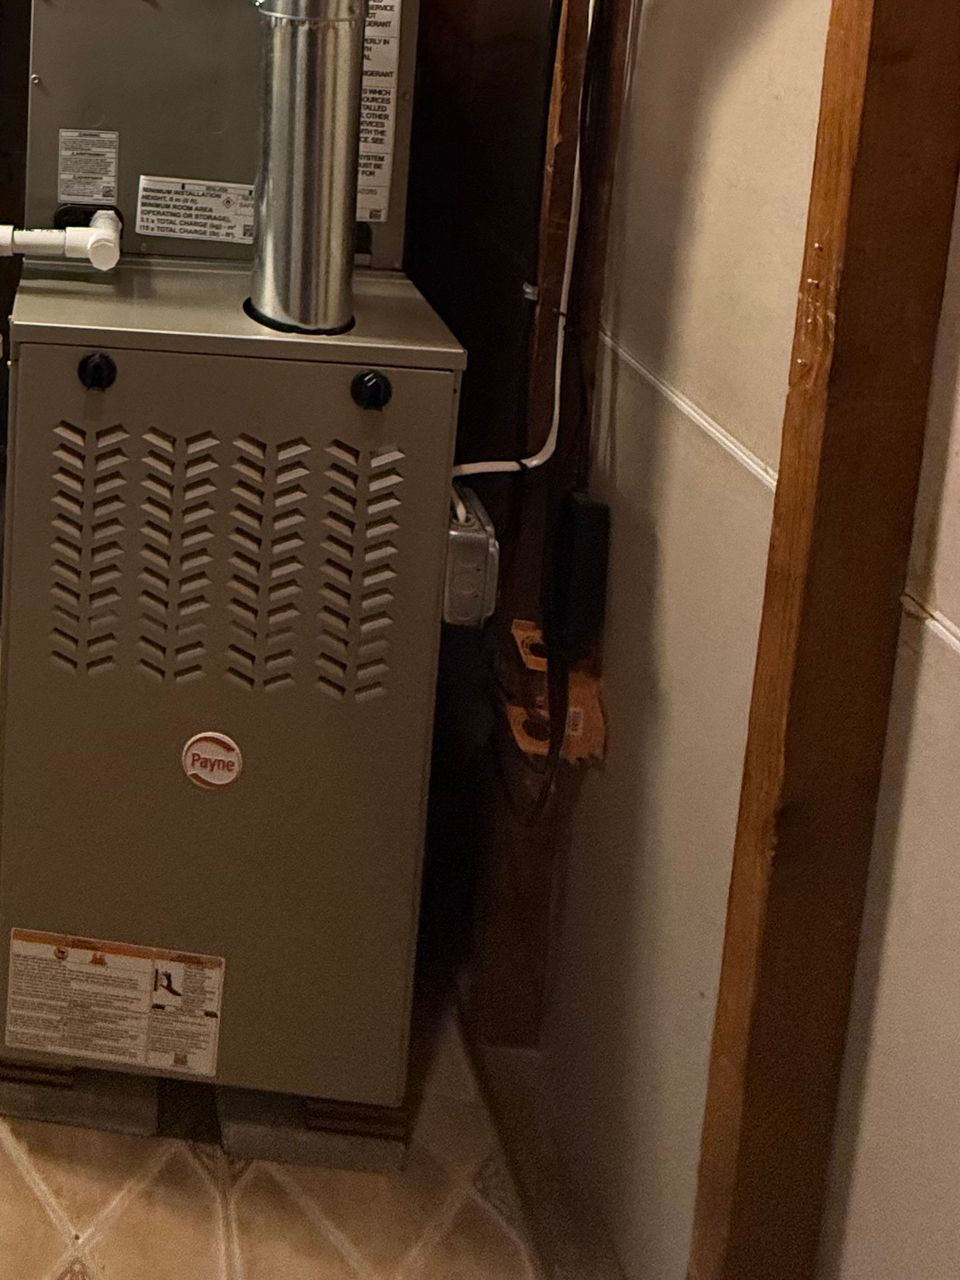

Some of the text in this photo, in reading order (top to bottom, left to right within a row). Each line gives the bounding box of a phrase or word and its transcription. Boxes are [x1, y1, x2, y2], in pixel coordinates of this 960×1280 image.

[173, 189, 221, 198] INSTALLATION
[141, 201, 171, 209] MINIMUM
[157, 218, 177, 226] TOTAL
[179, 220, 208, 228] CHARGE
[157, 225, 177, 233] TOTAL
[179, 227, 208, 236] CHARGE
[191, 752, 235, 772] Payne
